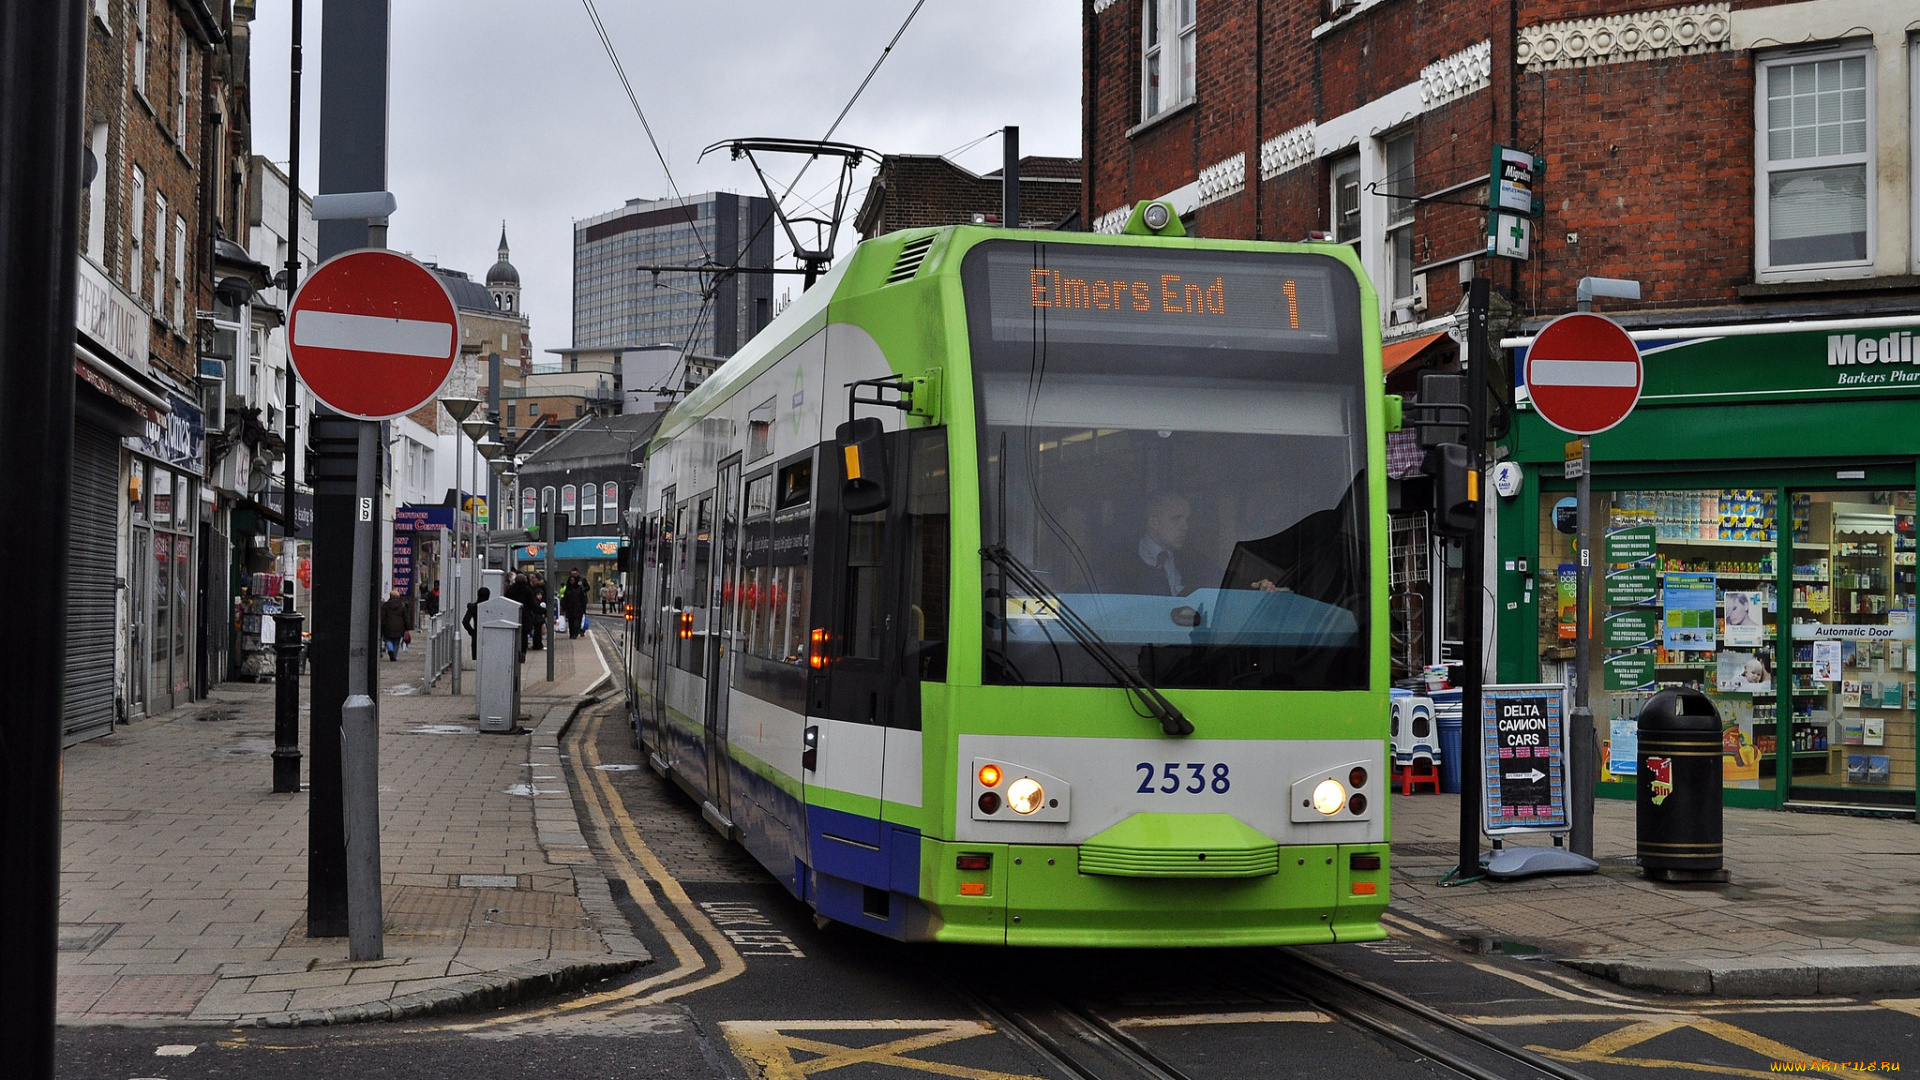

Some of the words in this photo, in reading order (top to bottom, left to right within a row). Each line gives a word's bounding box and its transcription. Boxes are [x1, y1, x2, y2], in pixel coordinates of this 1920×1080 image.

[1030, 268, 1150, 312] Elmers
[1161, 274, 1225, 315] End
[1282, 279, 1299, 329] 1
[109, 298, 136, 360] TIME
[1838, 373, 1886, 385] Barkers
[1815, 627, 1866, 637] Automatic
[1868, 627, 1894, 637] Door
[1504, 705, 1540, 717] DELTA
[1507, 734, 1540, 746] CARS
[1136, 762, 1230, 794] 2538
